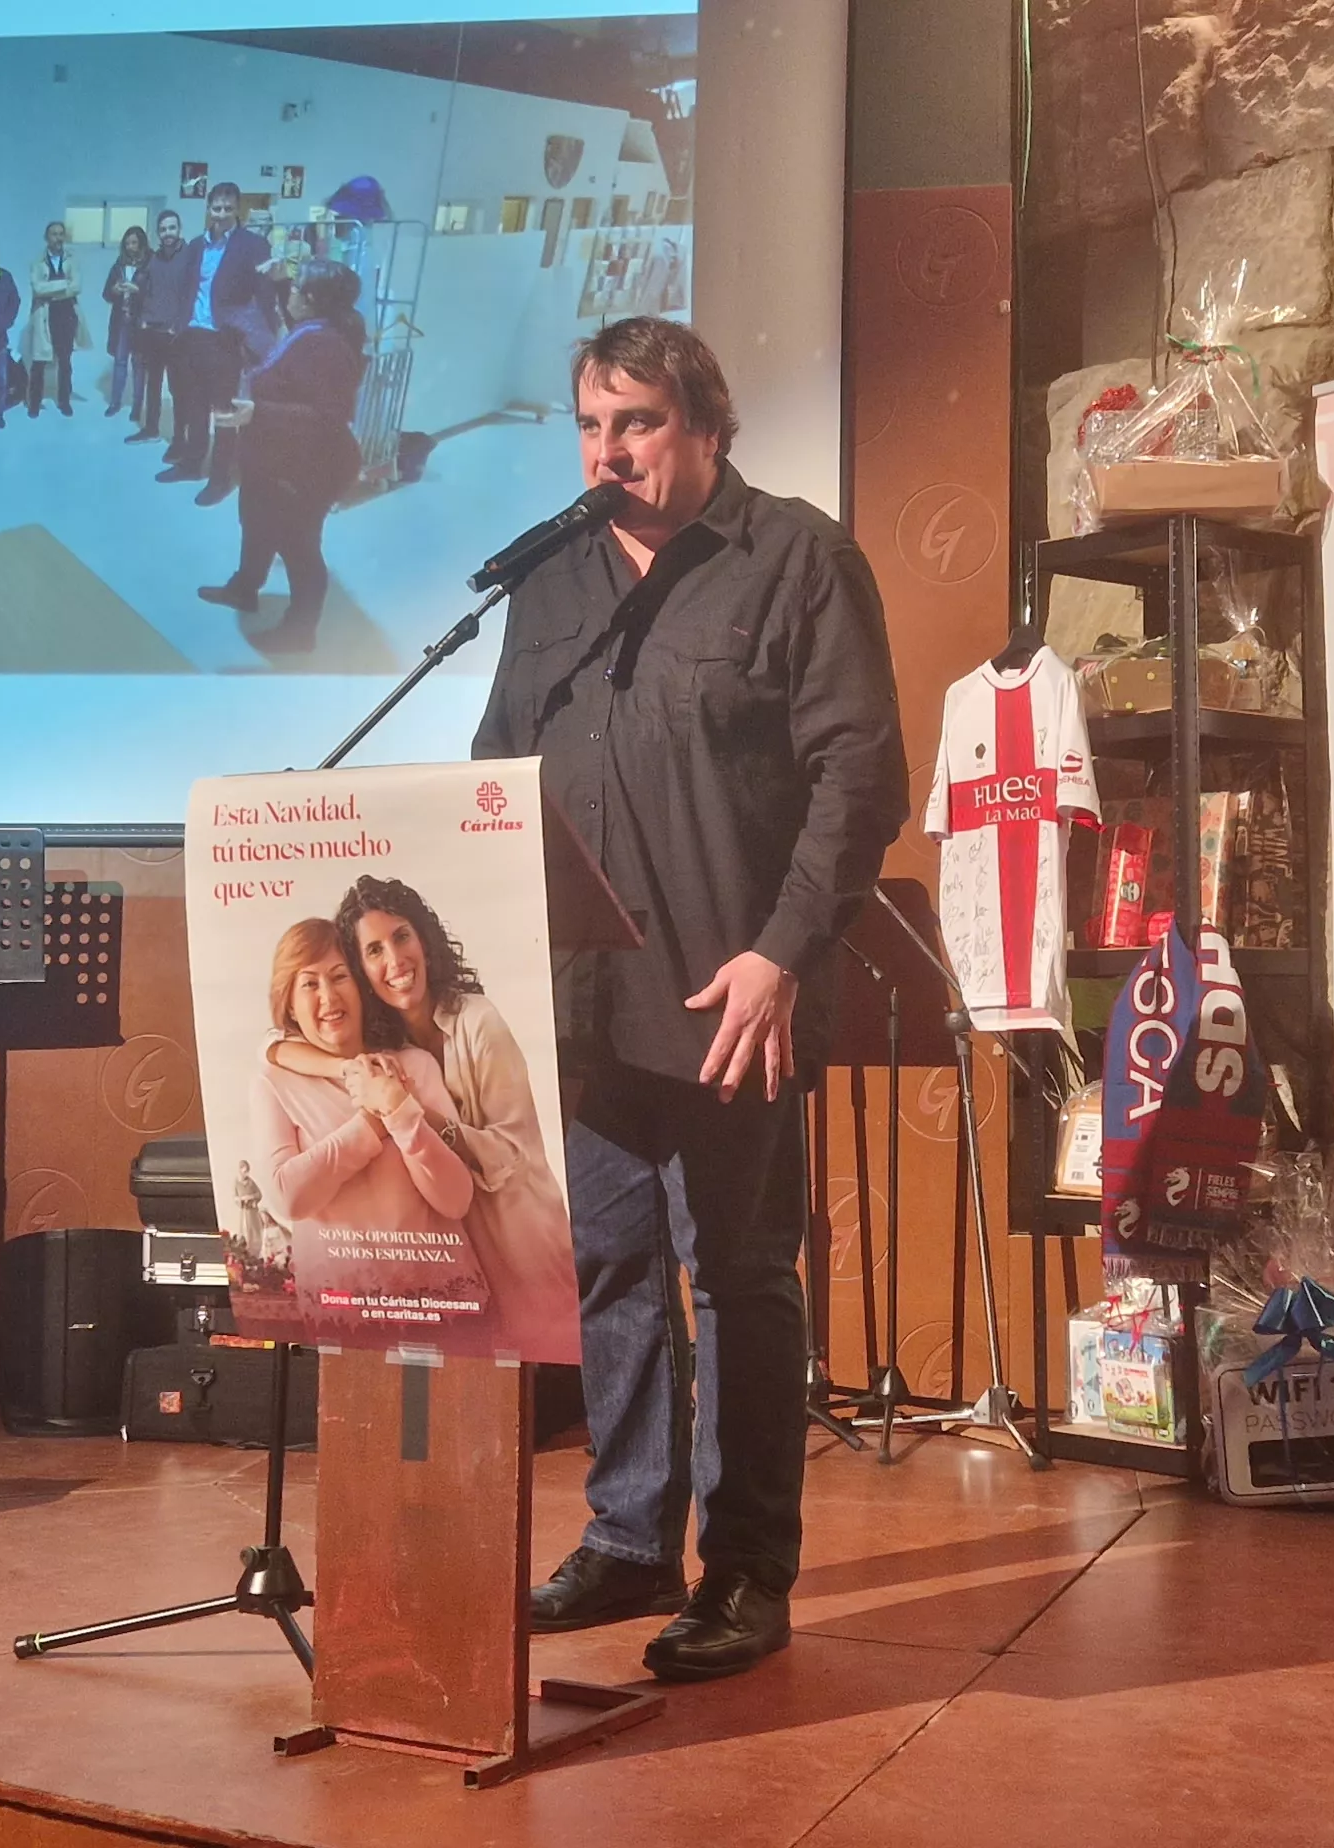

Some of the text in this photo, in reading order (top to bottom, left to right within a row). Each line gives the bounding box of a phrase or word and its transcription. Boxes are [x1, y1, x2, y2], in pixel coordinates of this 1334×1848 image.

[214, 804, 259, 827] Esta
[460, 819, 524, 833] Cáritas
[212, 831, 392, 863] tú tienes mucho
[214, 880, 295, 907] que ver
[318, 1228, 464, 1246] SOMOS OPORTUNIDAD.
[327, 1247, 456, 1263] SOMOS ESPERANZA.
[320, 1293, 480, 1312] Dona en tu Cáritas Diocesana
[361, 1308, 442, 1322] o en caritas.es
